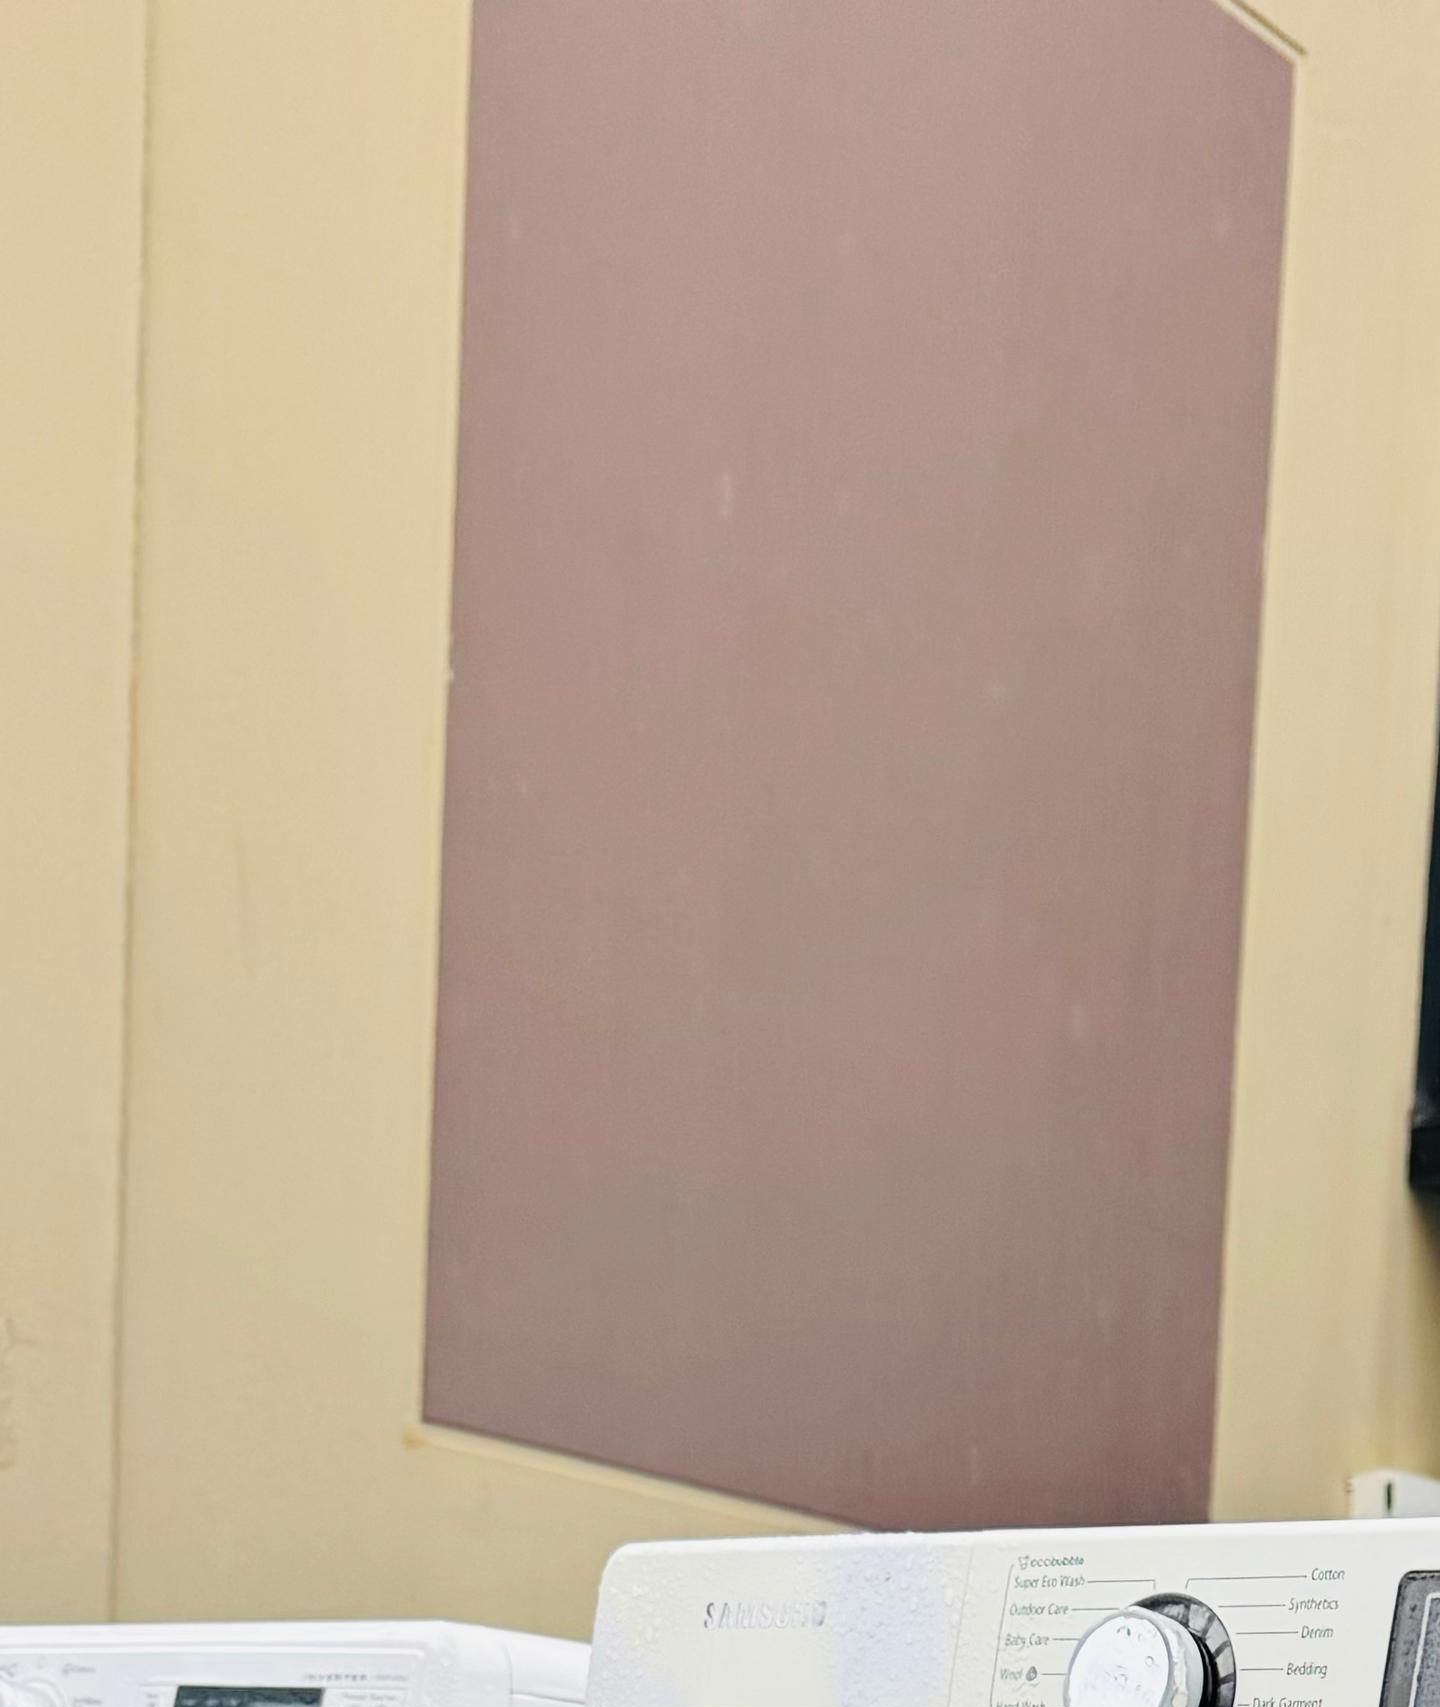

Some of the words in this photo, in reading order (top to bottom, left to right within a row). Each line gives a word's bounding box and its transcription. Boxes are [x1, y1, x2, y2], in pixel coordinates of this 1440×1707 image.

[1041, 1574, 1058, 1588] Eco
[1311, 1567, 1345, 1581] Cotton
[1048, 1602, 1070, 1616] Care
[1287, 1597, 1339, 1615] Synthetics
[703, 1599, 828, 1629] SAMSU
[1301, 1624, 1335, 1639] Denim
[1029, 1632, 1050, 1646] Care
[1286, 1661, 1328, 1680] Bedding
